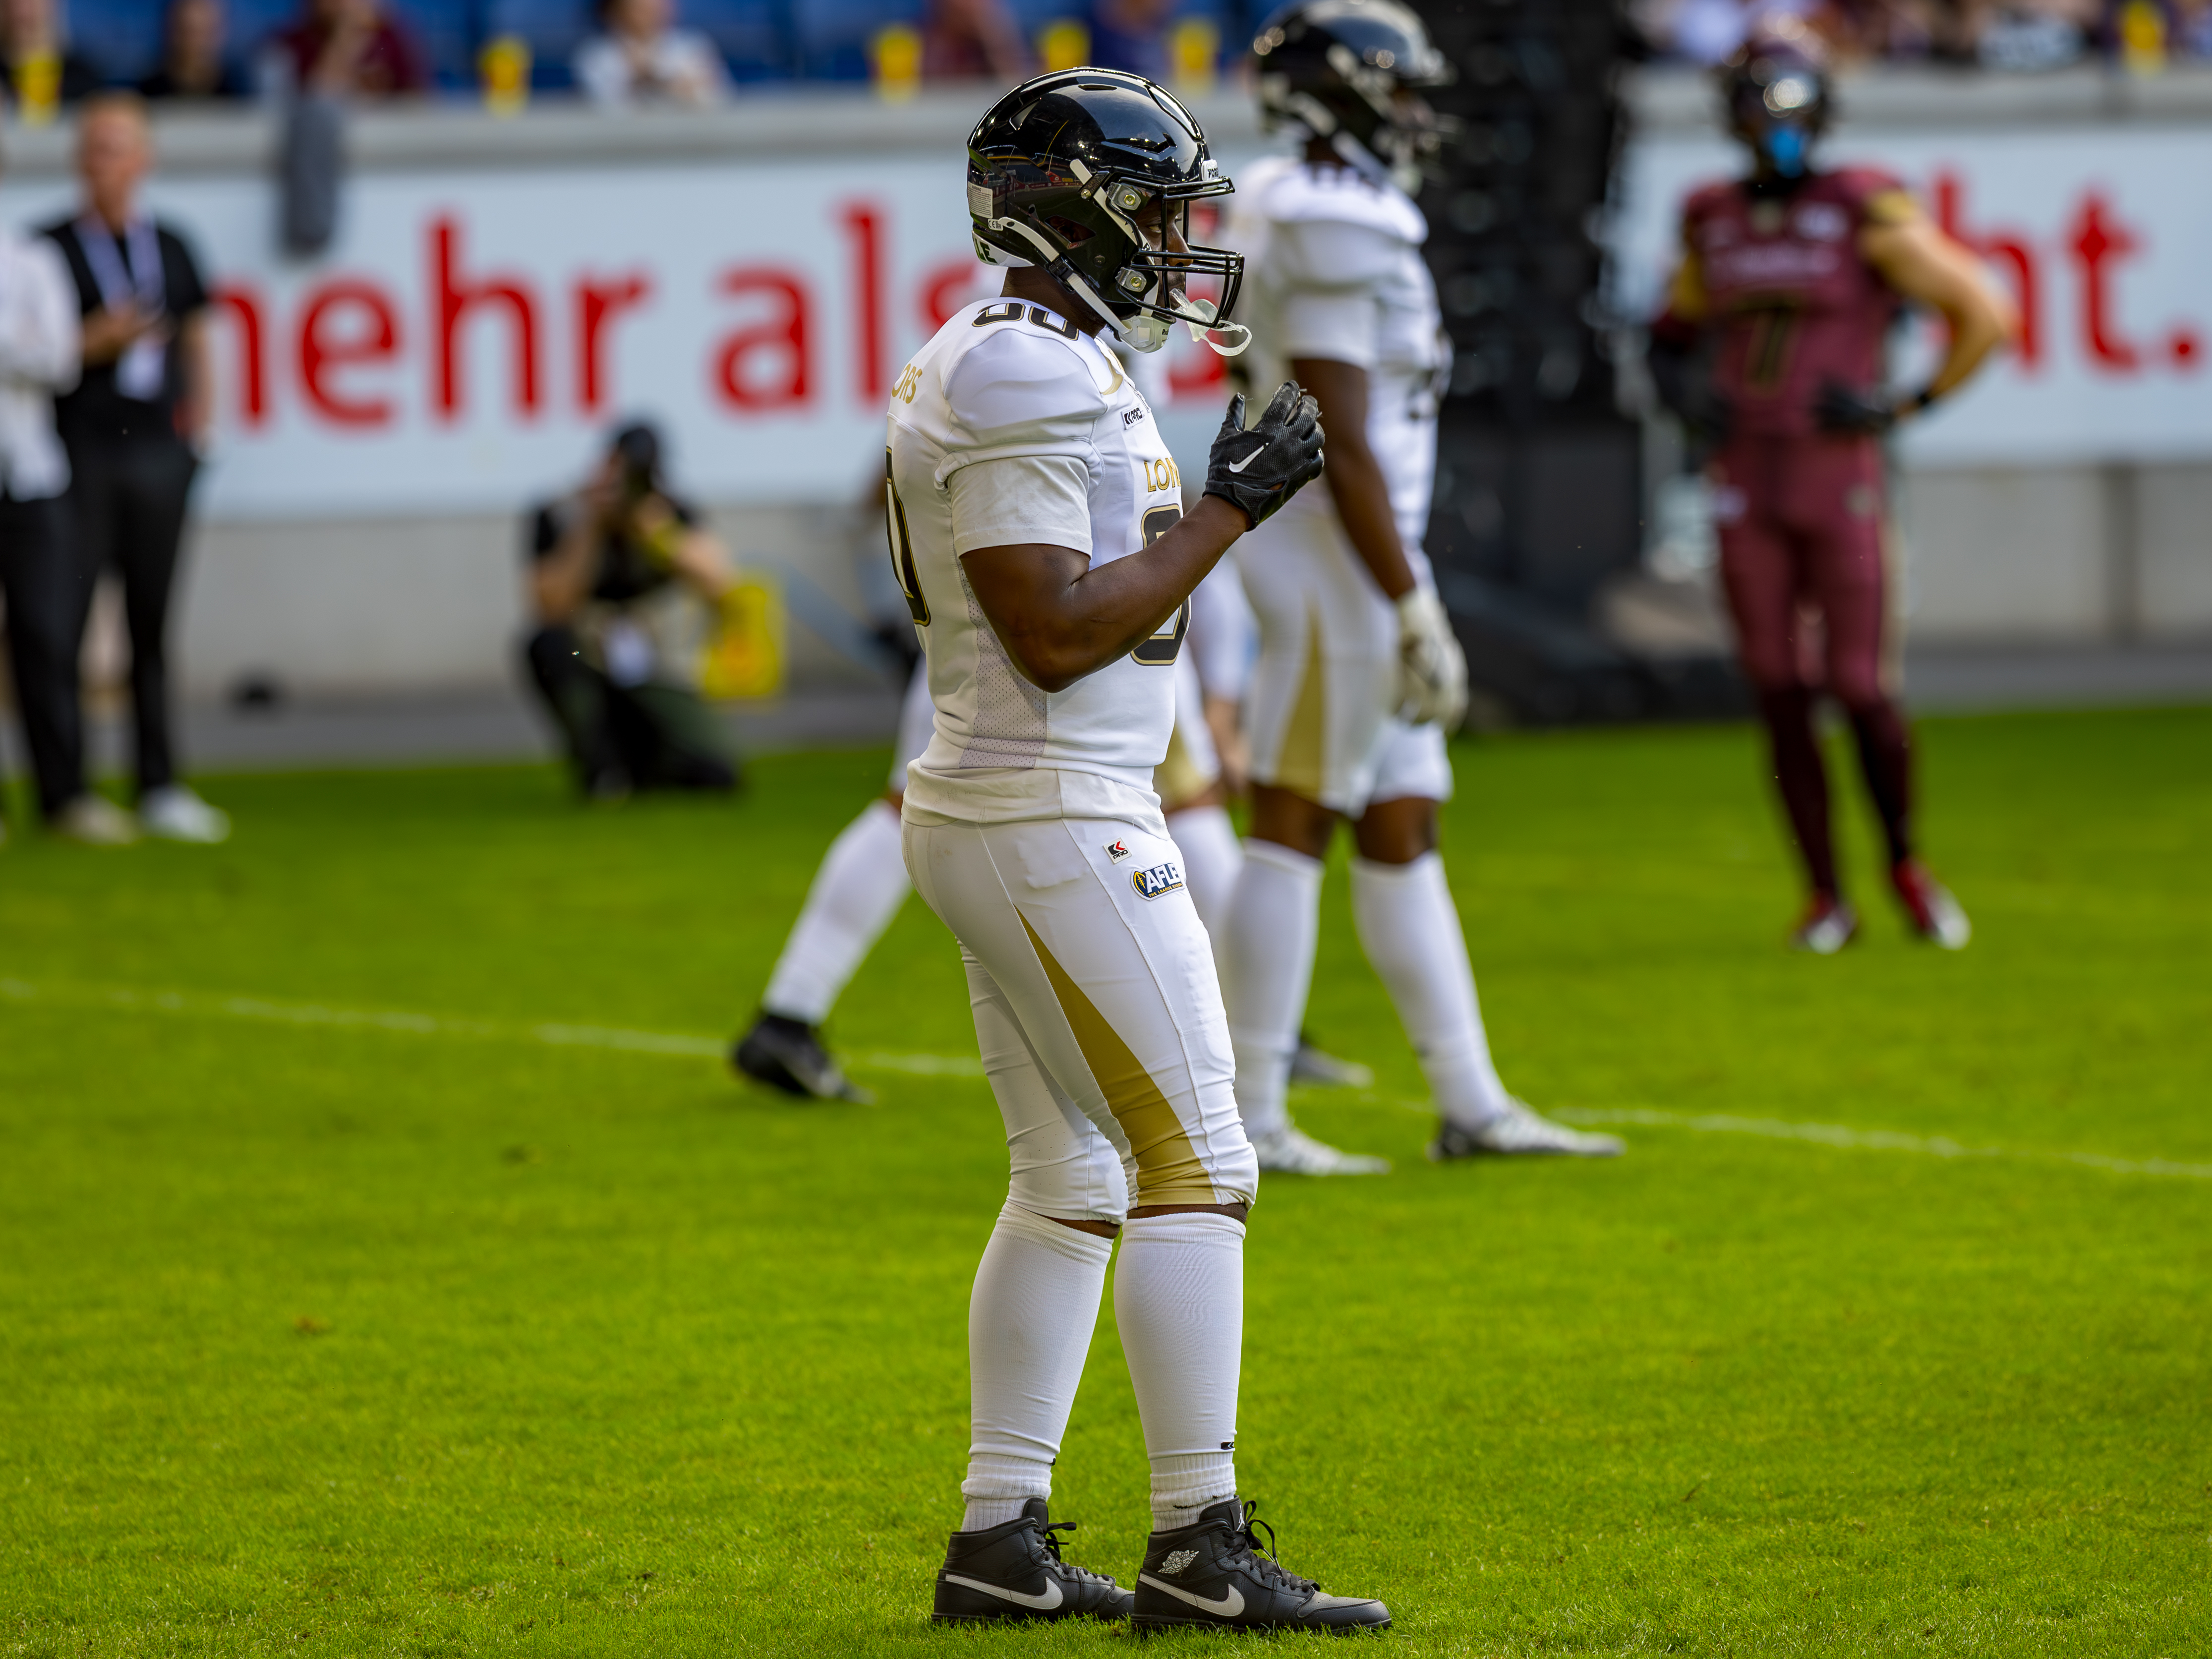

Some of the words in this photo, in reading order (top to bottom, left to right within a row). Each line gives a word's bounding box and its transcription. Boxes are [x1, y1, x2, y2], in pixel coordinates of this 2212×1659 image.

[975, 238, 998, 264] LE
[892, 363, 923, 404] ORS
[1143, 457, 1181, 493] LON
[1112, 849, 1128, 860] PRO
[1144, 863, 1181, 893] AFLE
[1157, 886, 1173, 894] LEAGUE
